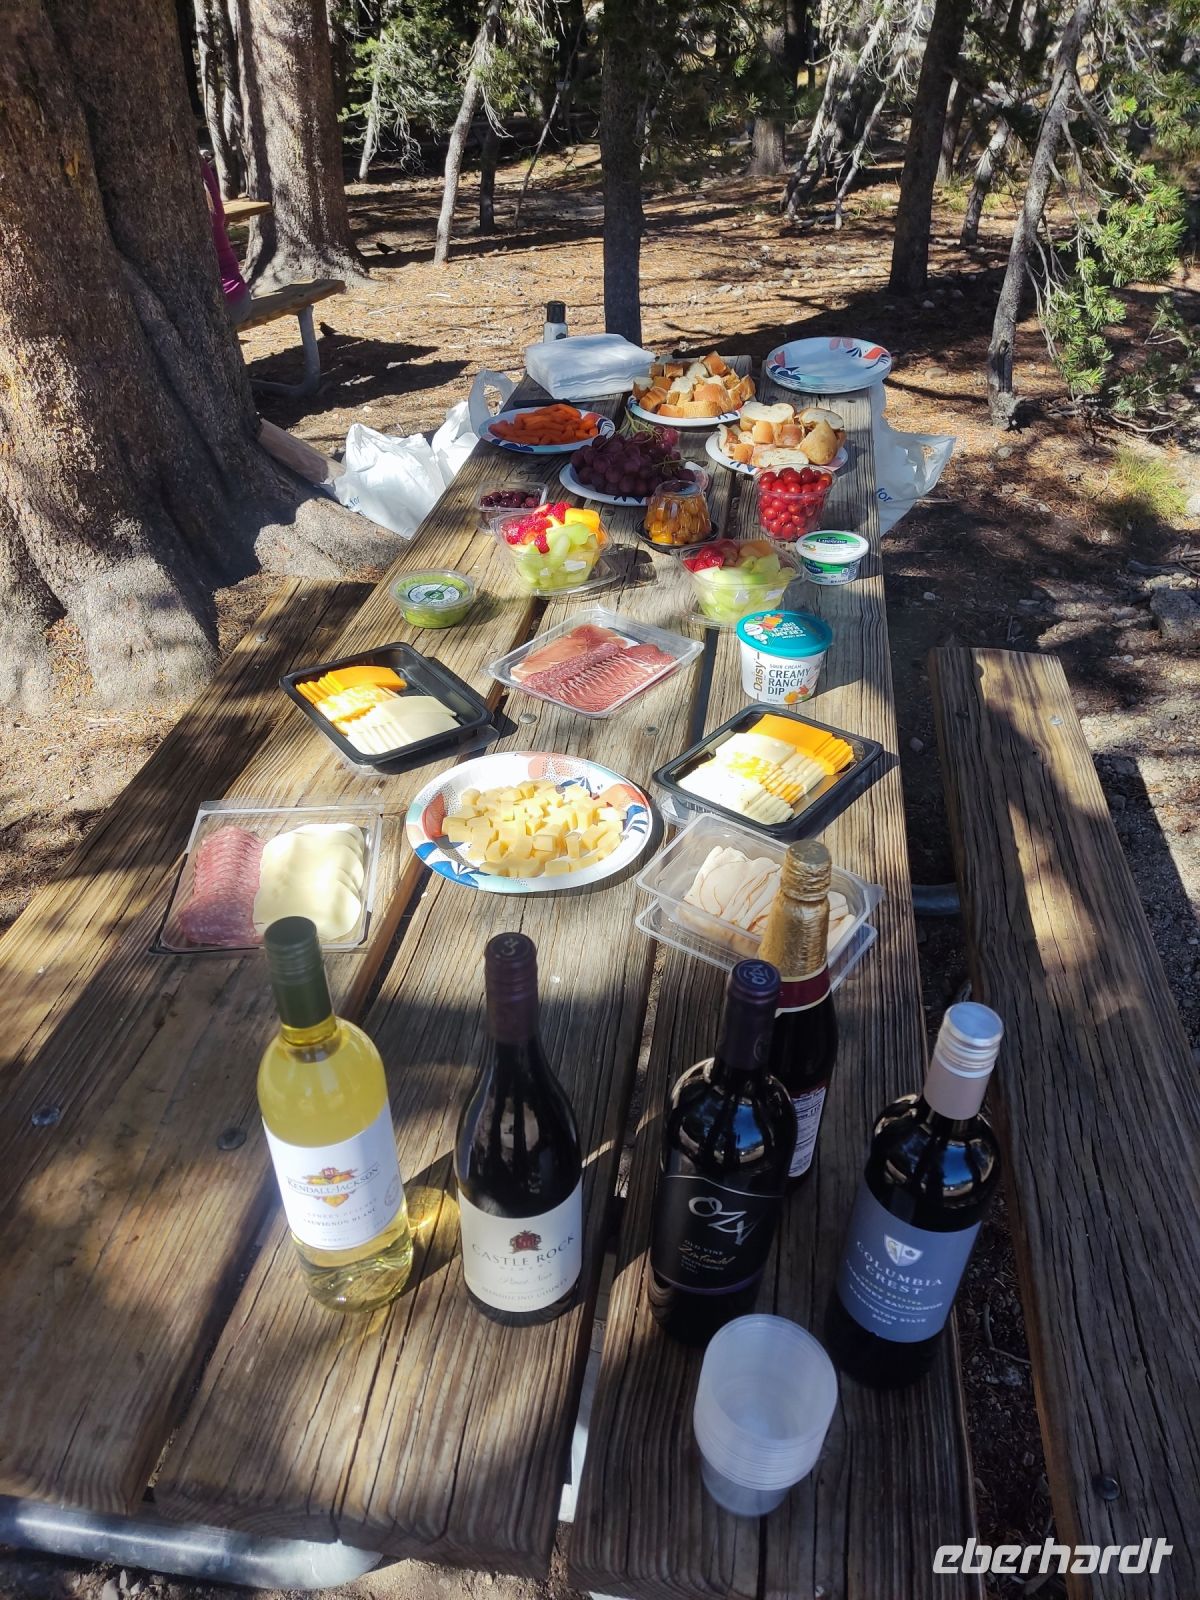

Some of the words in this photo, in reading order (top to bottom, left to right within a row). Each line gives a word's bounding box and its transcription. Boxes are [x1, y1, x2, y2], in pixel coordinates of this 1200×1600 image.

[753, 658, 766, 692] Daisy
[768, 667, 811, 679] CREAMY
[768, 678, 803, 687] RANCH
[767, 686, 785, 696] DIP
[472, 1243, 529, 1267] CASTLE
[536, 1234, 575, 1263] ROCK
[856, 1240, 943, 1286] COLUMBIA
[865, 1263, 924, 1295] CREST
